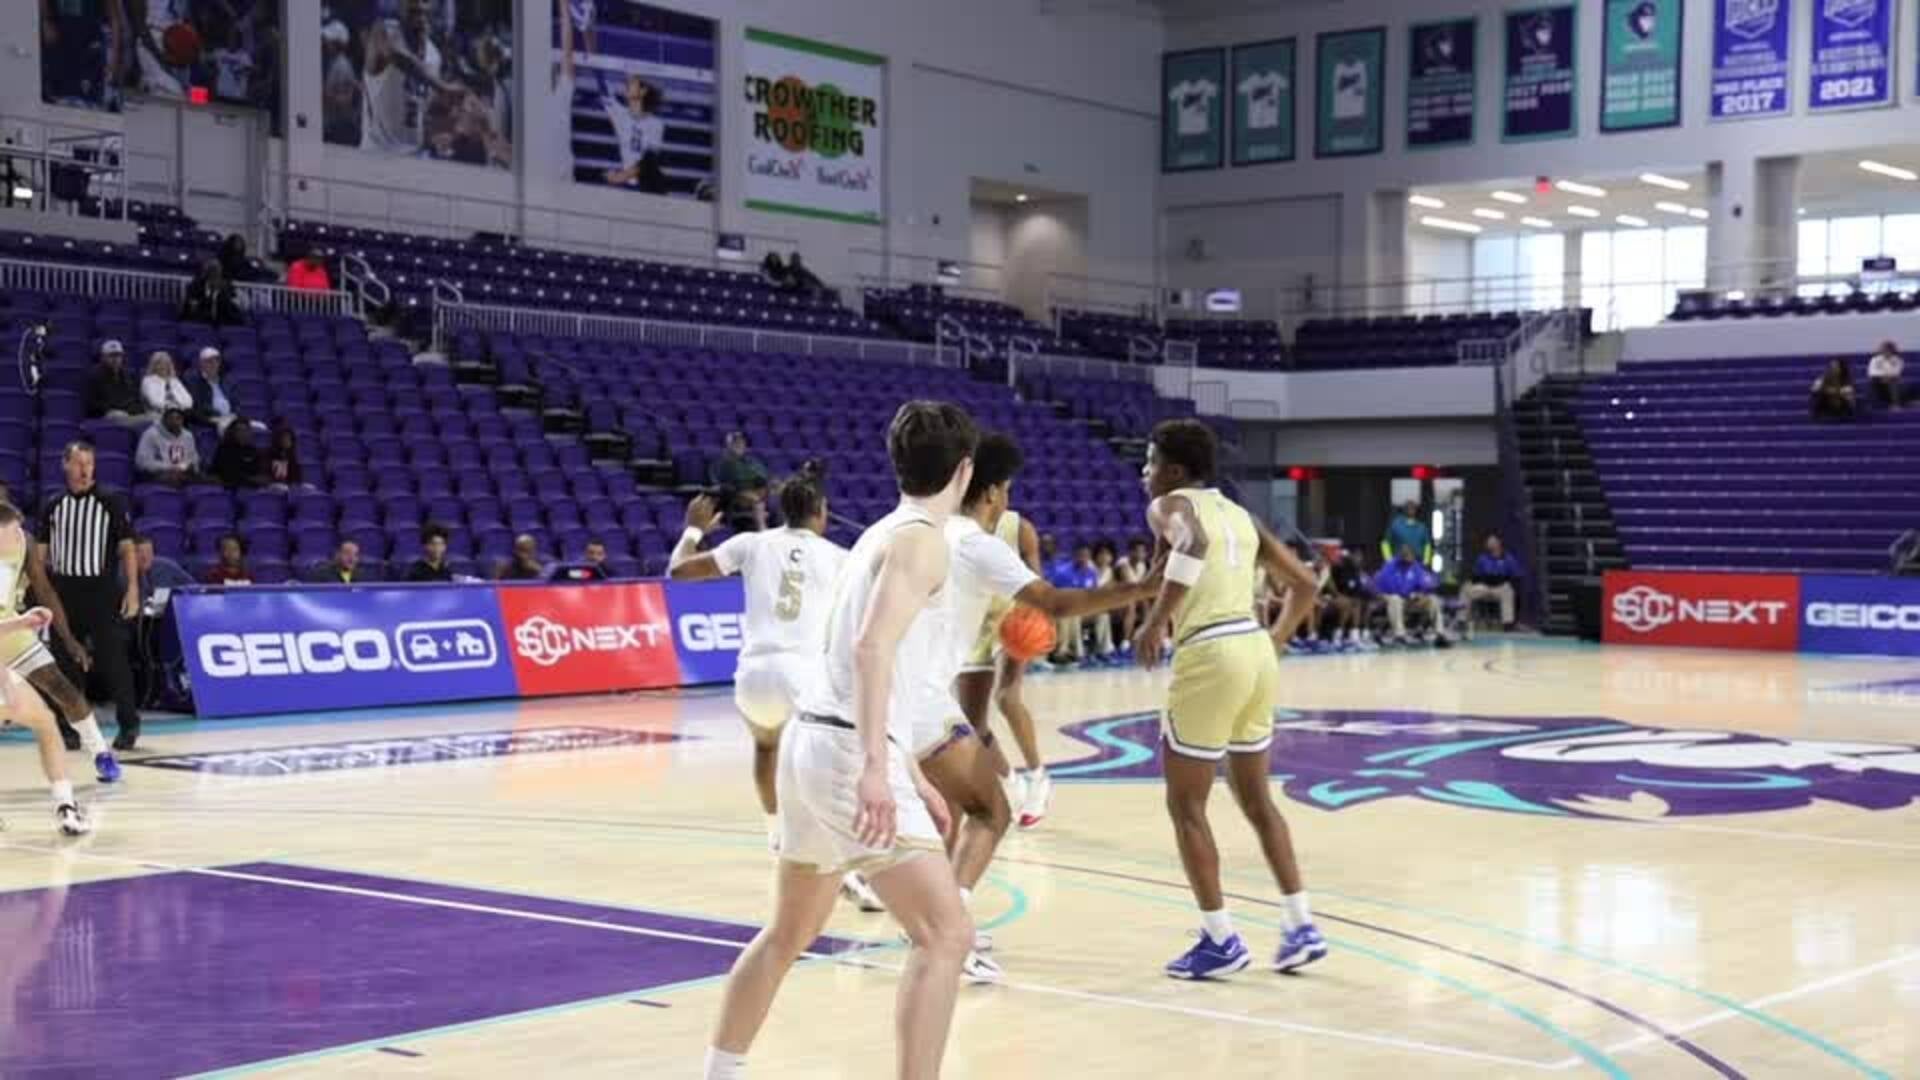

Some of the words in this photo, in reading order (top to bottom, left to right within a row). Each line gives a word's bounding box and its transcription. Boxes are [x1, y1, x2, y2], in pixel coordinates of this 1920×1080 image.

[1721, 92, 1776, 114] 2017
[1819, 76, 1876, 101] 2021
[754, 111, 865, 158] ROOFING
[775, 569, 805, 622] 5
[197, 628, 392, 678] GEICO
